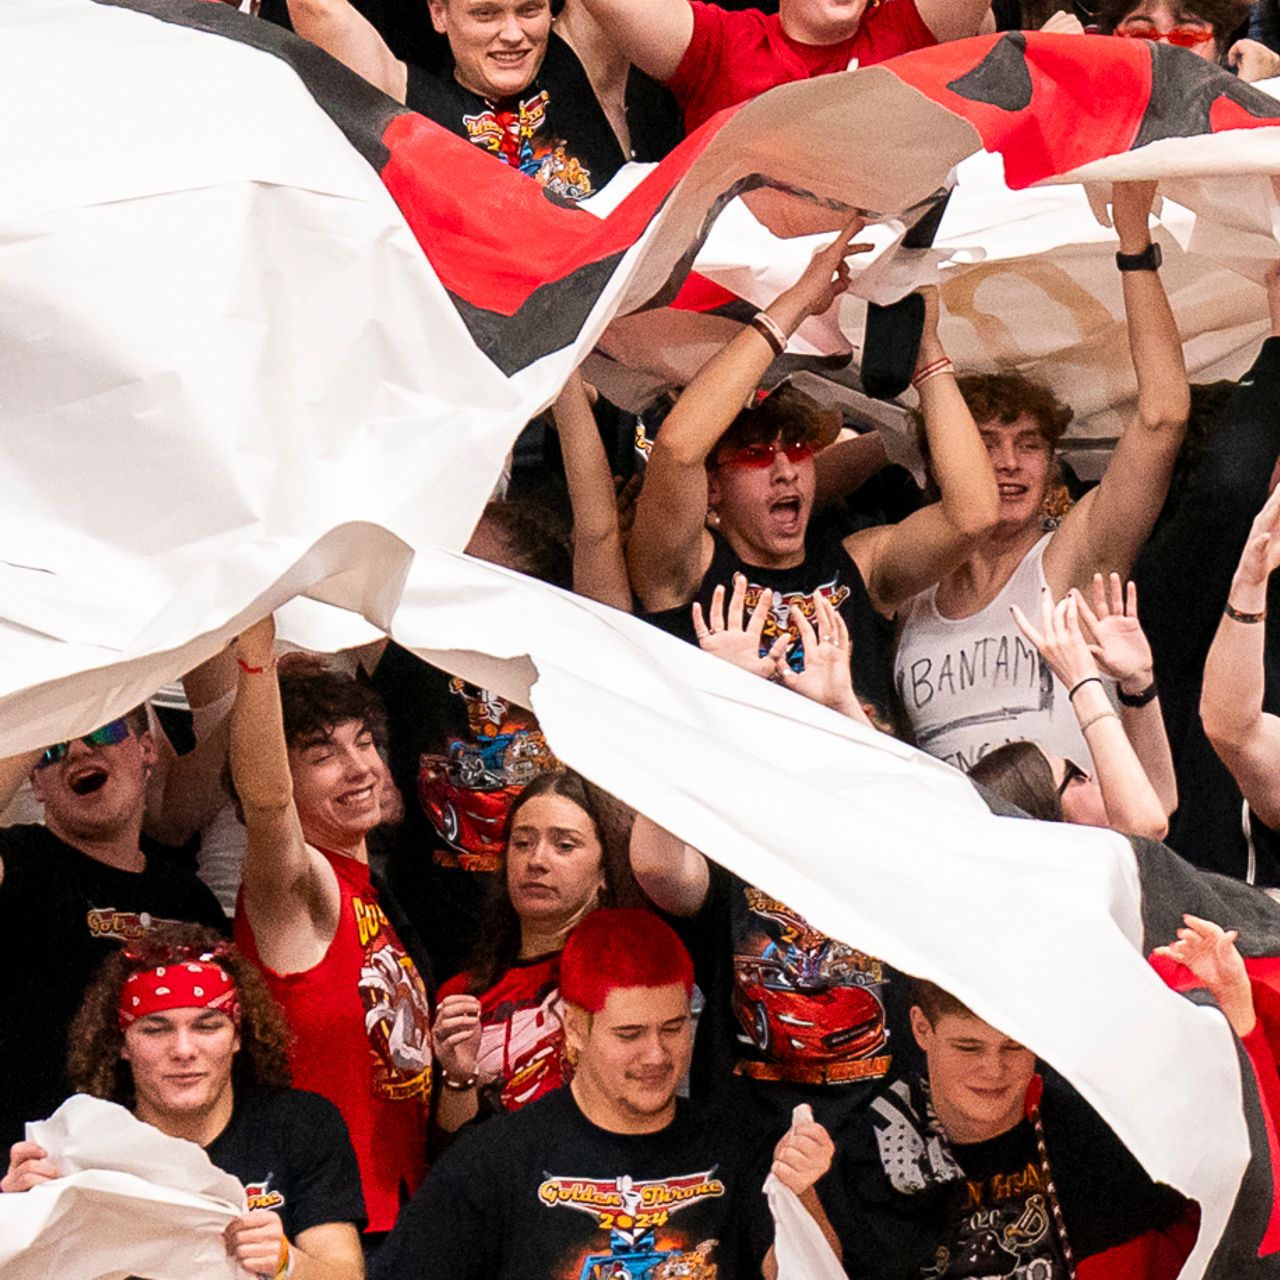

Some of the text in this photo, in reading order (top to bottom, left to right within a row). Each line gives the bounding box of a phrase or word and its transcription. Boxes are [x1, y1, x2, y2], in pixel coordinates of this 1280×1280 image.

[911, 633, 1039, 708] BANTAM
[538, 1179, 725, 1207] Golden Throne
